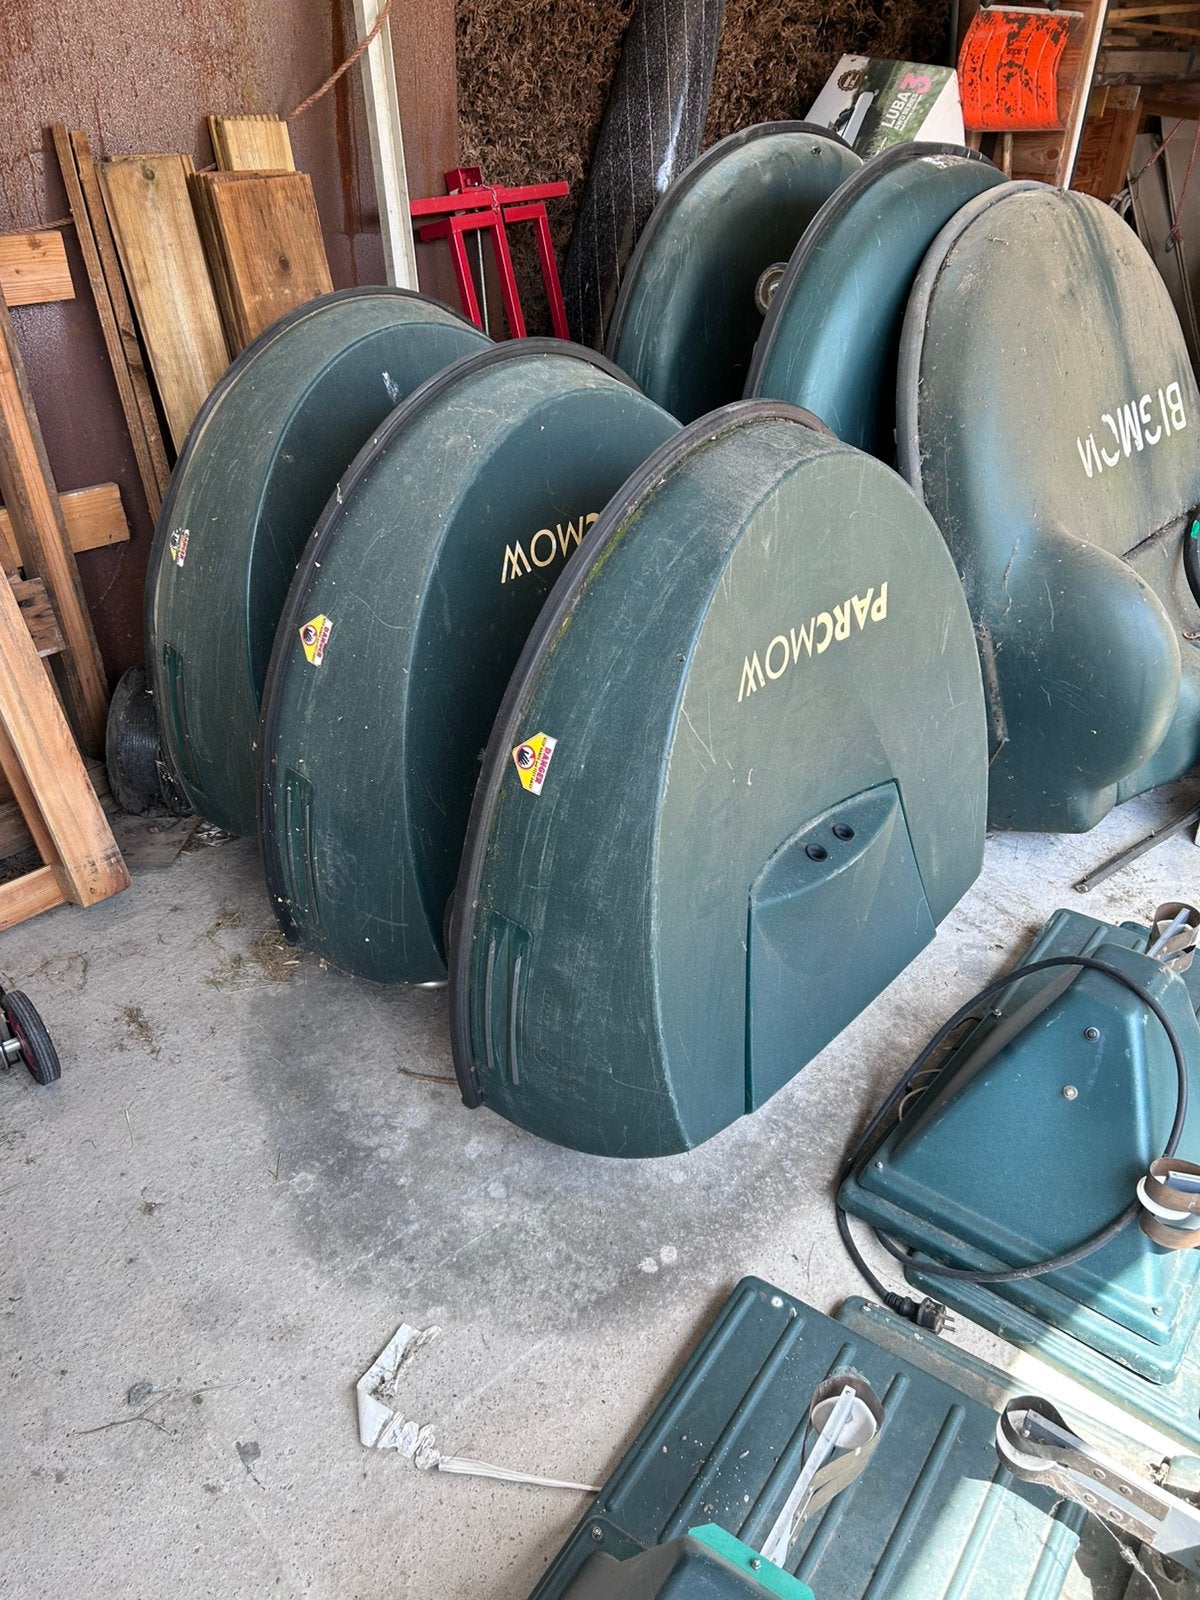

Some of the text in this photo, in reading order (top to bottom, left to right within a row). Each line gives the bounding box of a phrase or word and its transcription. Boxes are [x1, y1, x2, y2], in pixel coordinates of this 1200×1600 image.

[881, 92, 912, 128] LUBA
[900, 72, 932, 94] 3
[501, 512, 600, 584] MOW
[738, 582, 888, 703] PARCMOW
[535, 747, 552, 784] DANGER
